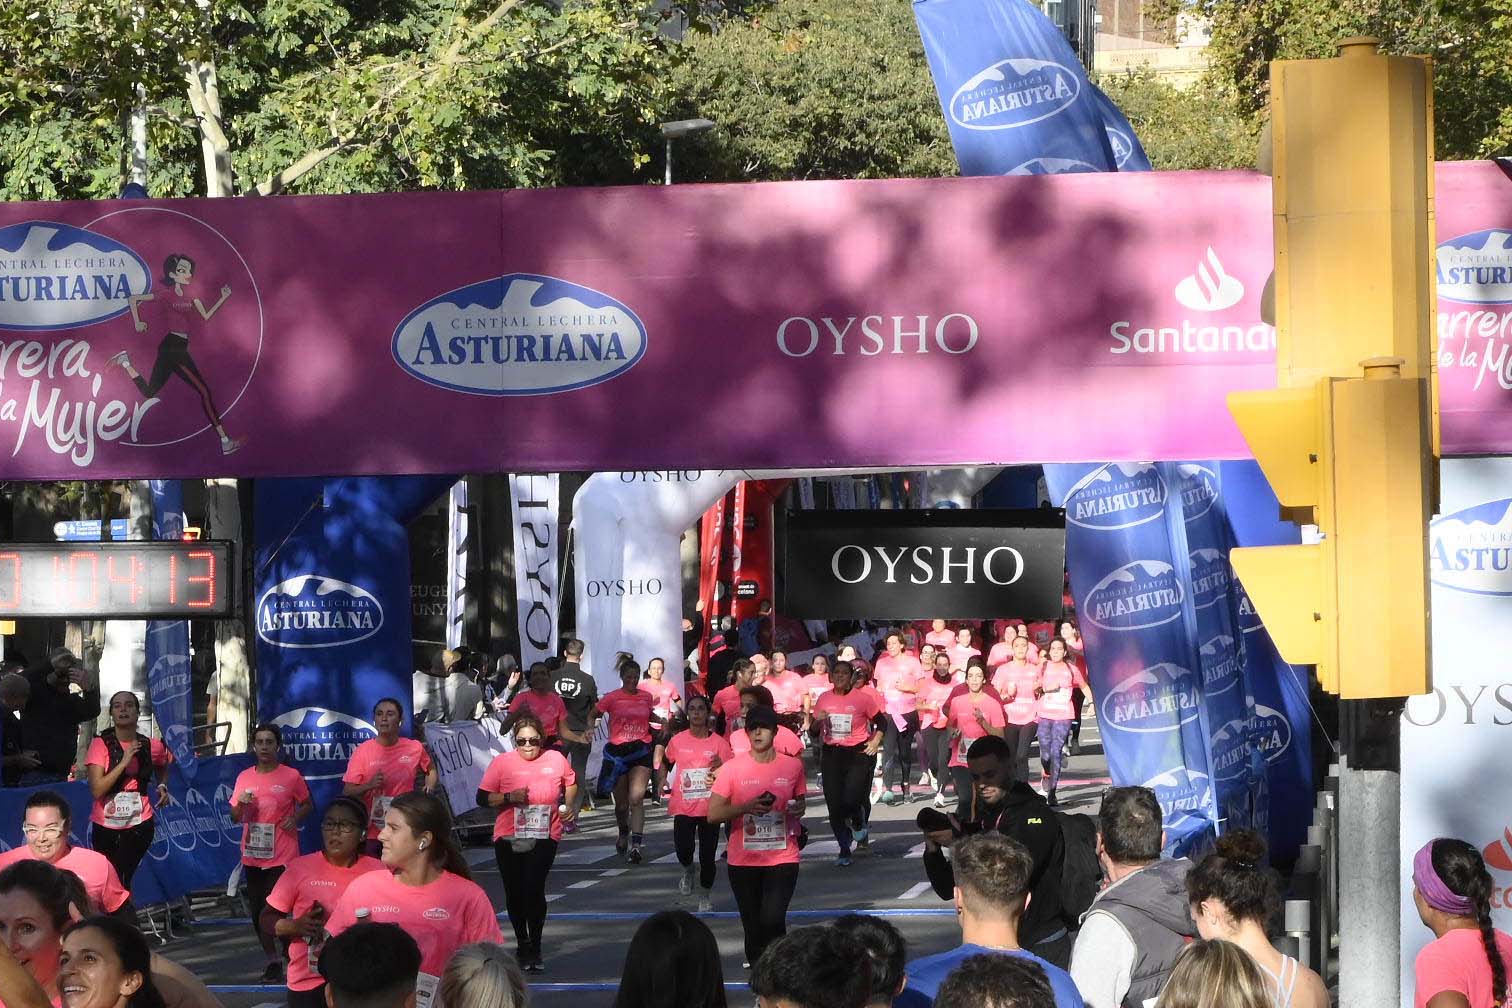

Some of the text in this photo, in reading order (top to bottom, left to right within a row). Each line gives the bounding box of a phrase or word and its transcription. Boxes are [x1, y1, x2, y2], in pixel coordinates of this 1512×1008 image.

[53, 256, 127, 270] LECHERA
[450, 313, 619, 330] CENTRAL LECHERA
[776, 312, 980, 359] OYSHO
[411, 321, 629, 367] ASTURIANA
[1460, 339, 1477, 368] la
[13, 373, 161, 467] Mujer
[831, 545, 1024, 586] OYSHO
[586, 578, 663, 598] OYSHO
[261, 604, 375, 632] ASTURIANA
[561, 682, 575, 691] BP
